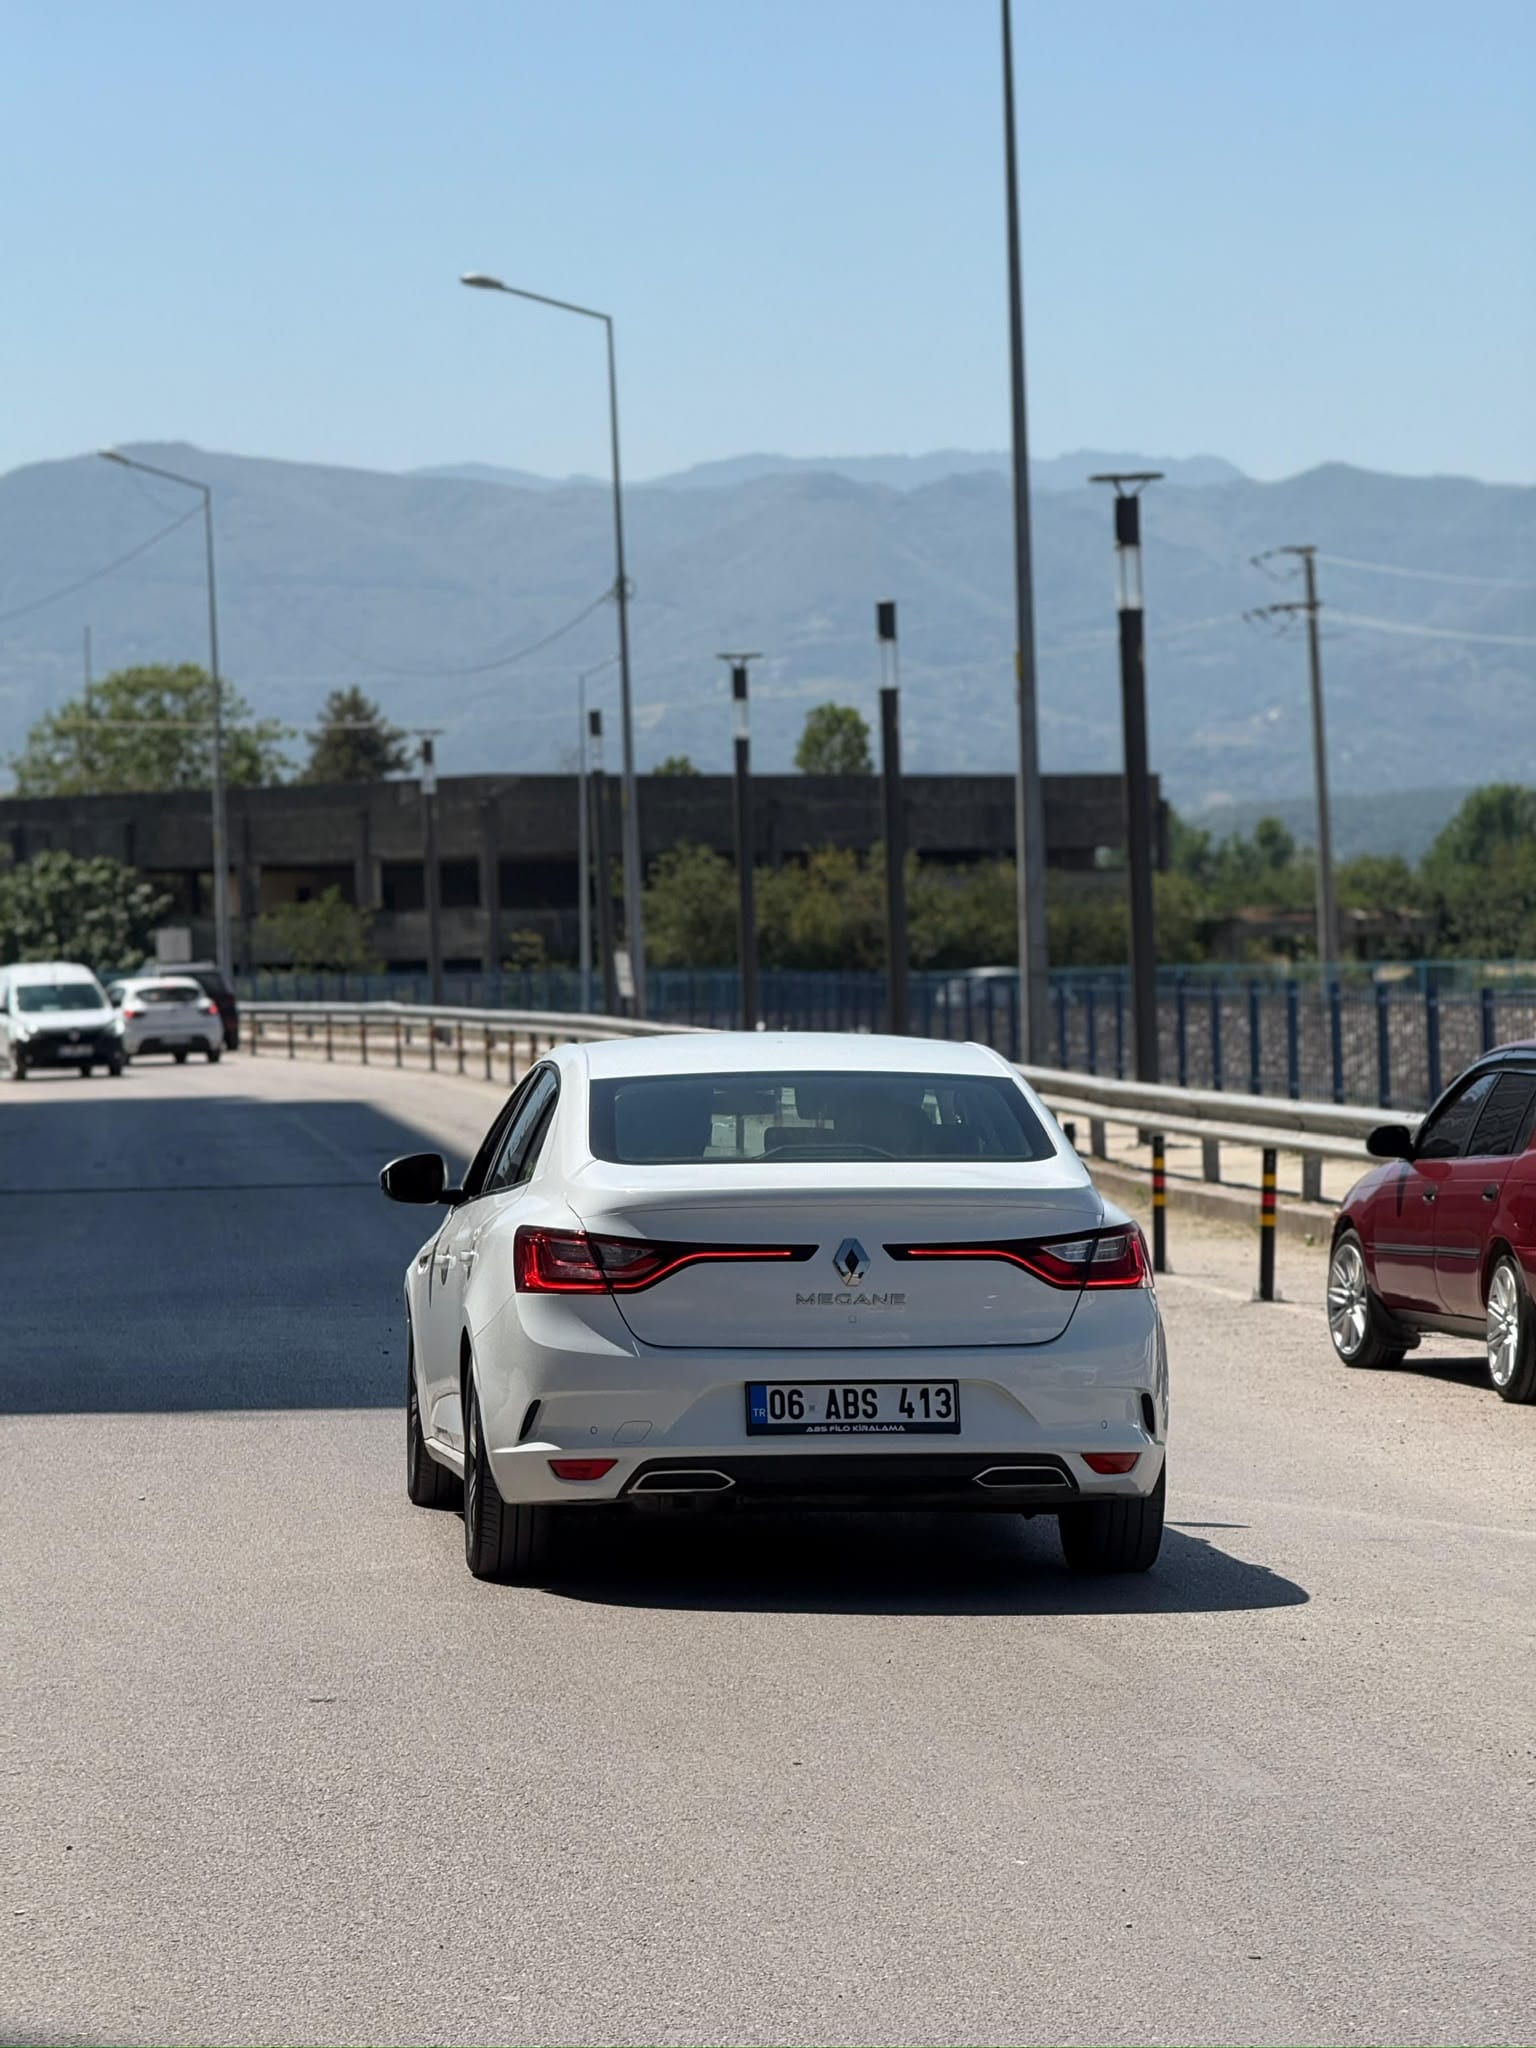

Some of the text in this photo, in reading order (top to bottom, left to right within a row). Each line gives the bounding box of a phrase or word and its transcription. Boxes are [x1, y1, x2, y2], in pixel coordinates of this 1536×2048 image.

[796, 1293, 907, 1305] MEGANE
[769, 1387, 952, 1420] 06 ABS 413
[753, 1408, 766, 1417] TR
